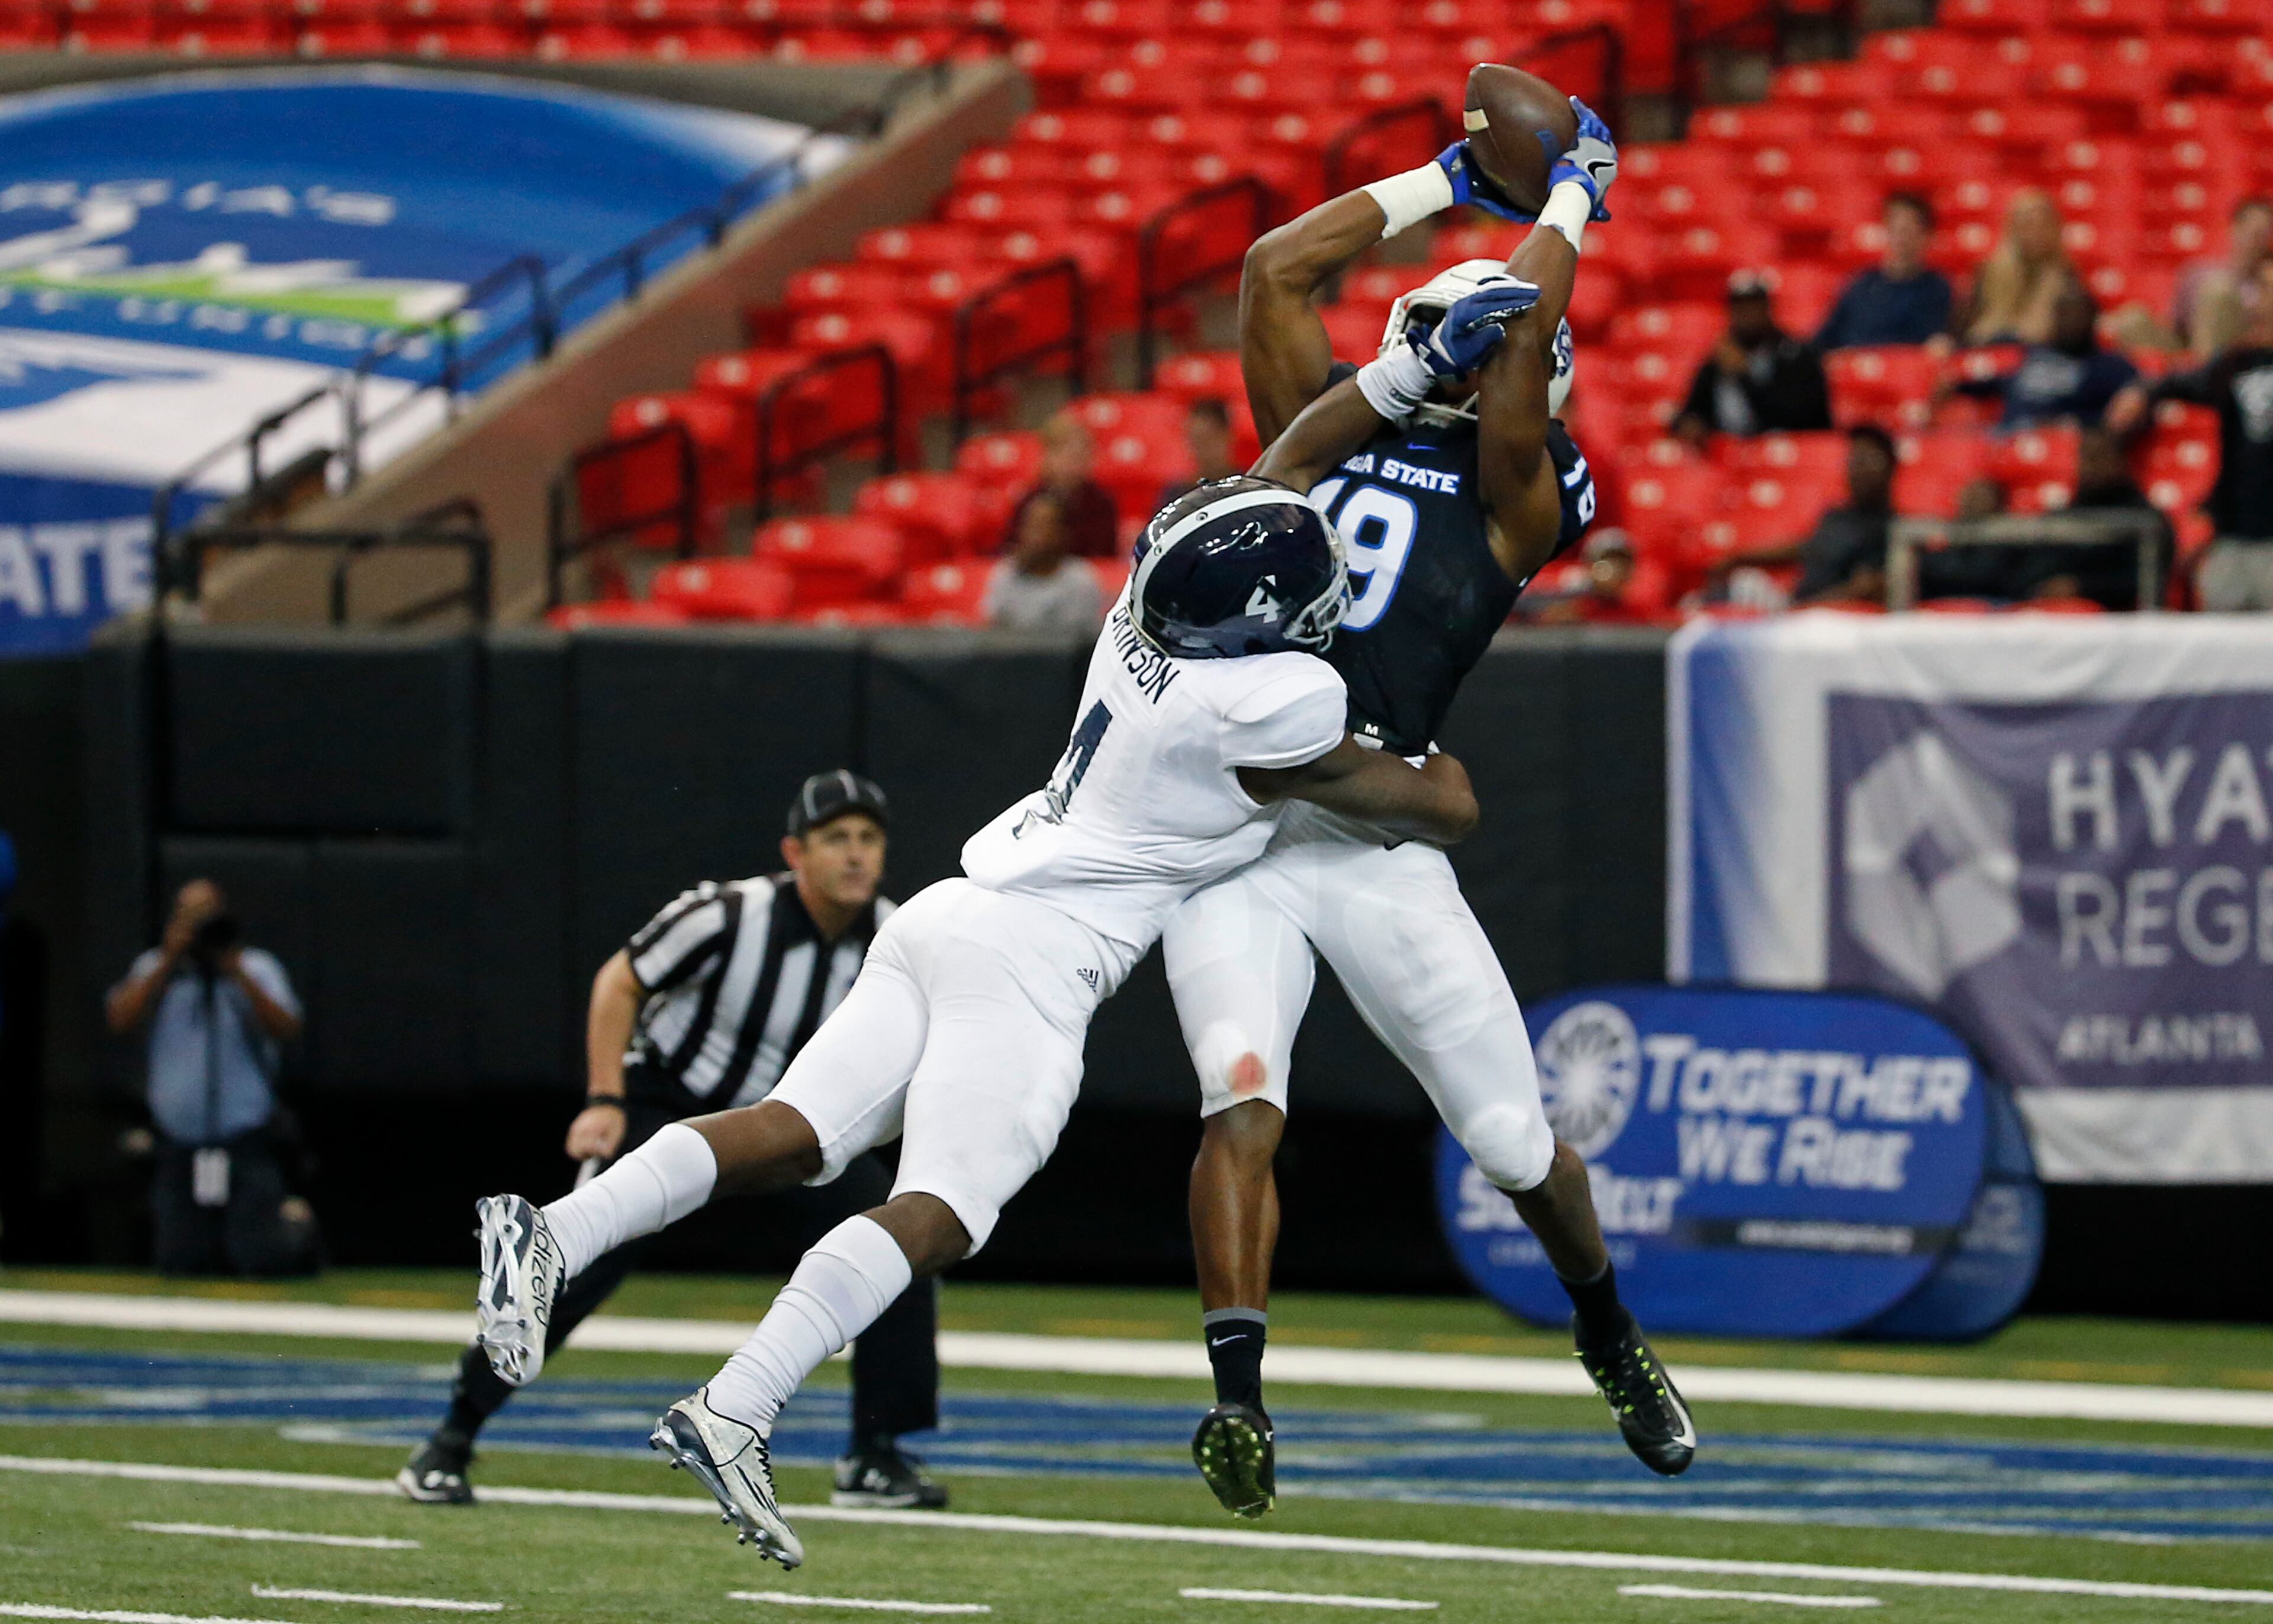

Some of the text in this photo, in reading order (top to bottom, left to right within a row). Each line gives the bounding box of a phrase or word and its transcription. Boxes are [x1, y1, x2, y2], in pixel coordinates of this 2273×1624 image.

[1380, 458, 1459, 494] STATE
[1245, 574, 1279, 624] 4
[2048, 742, 2273, 852] HYA
[2056, 1013, 2265, 1064] ATLANTA
[1642, 1034, 1973, 1123] TOGETHER
[1677, 1116, 1775, 1185] WE
